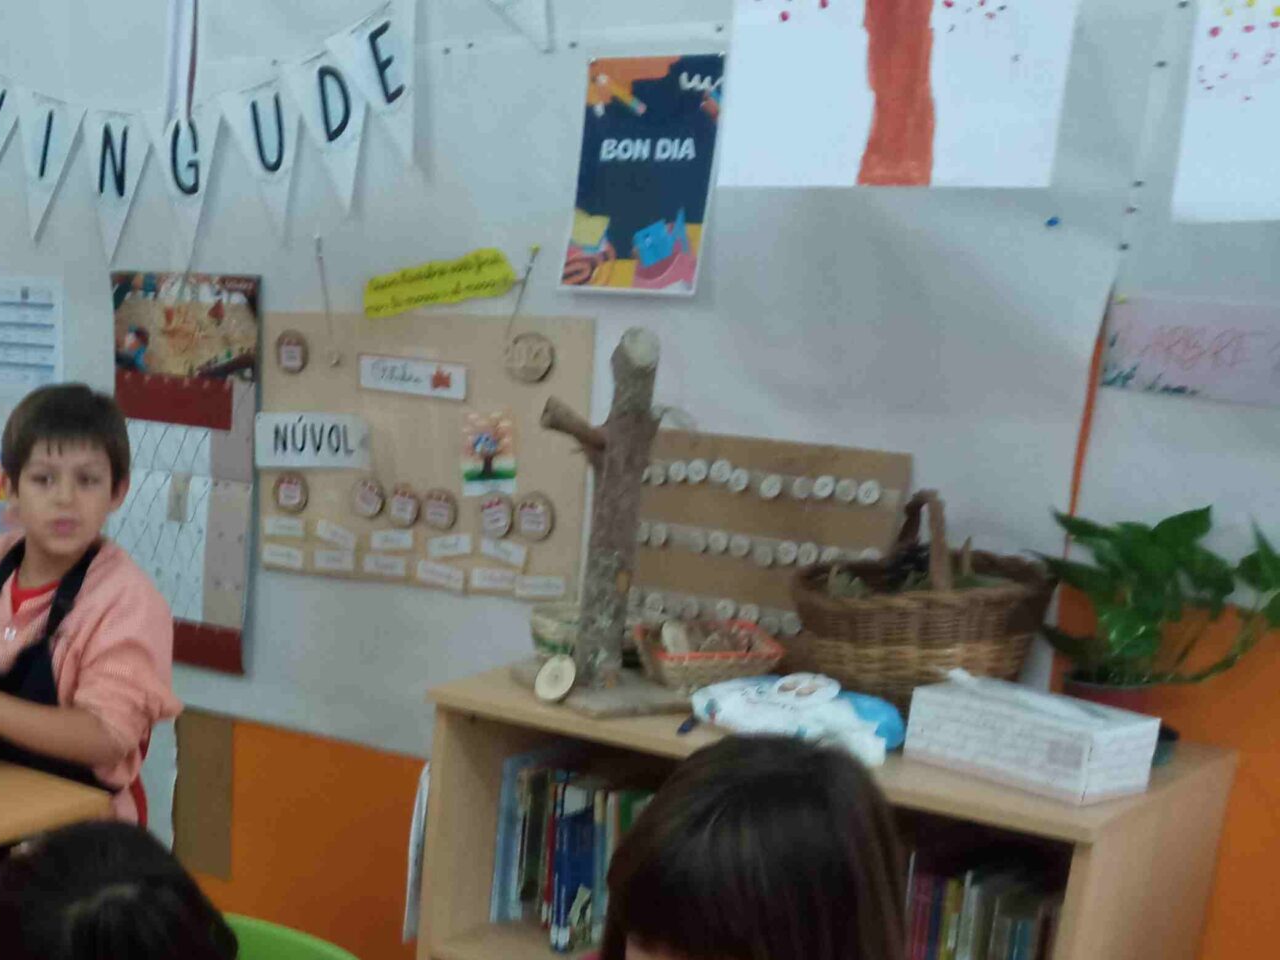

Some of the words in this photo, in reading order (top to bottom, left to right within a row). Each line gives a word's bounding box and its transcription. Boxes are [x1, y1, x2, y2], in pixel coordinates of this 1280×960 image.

[599, 137, 651, 162] BON
[654, 136, 697, 161] DIA
[273, 414, 356, 456] NÚVOL
